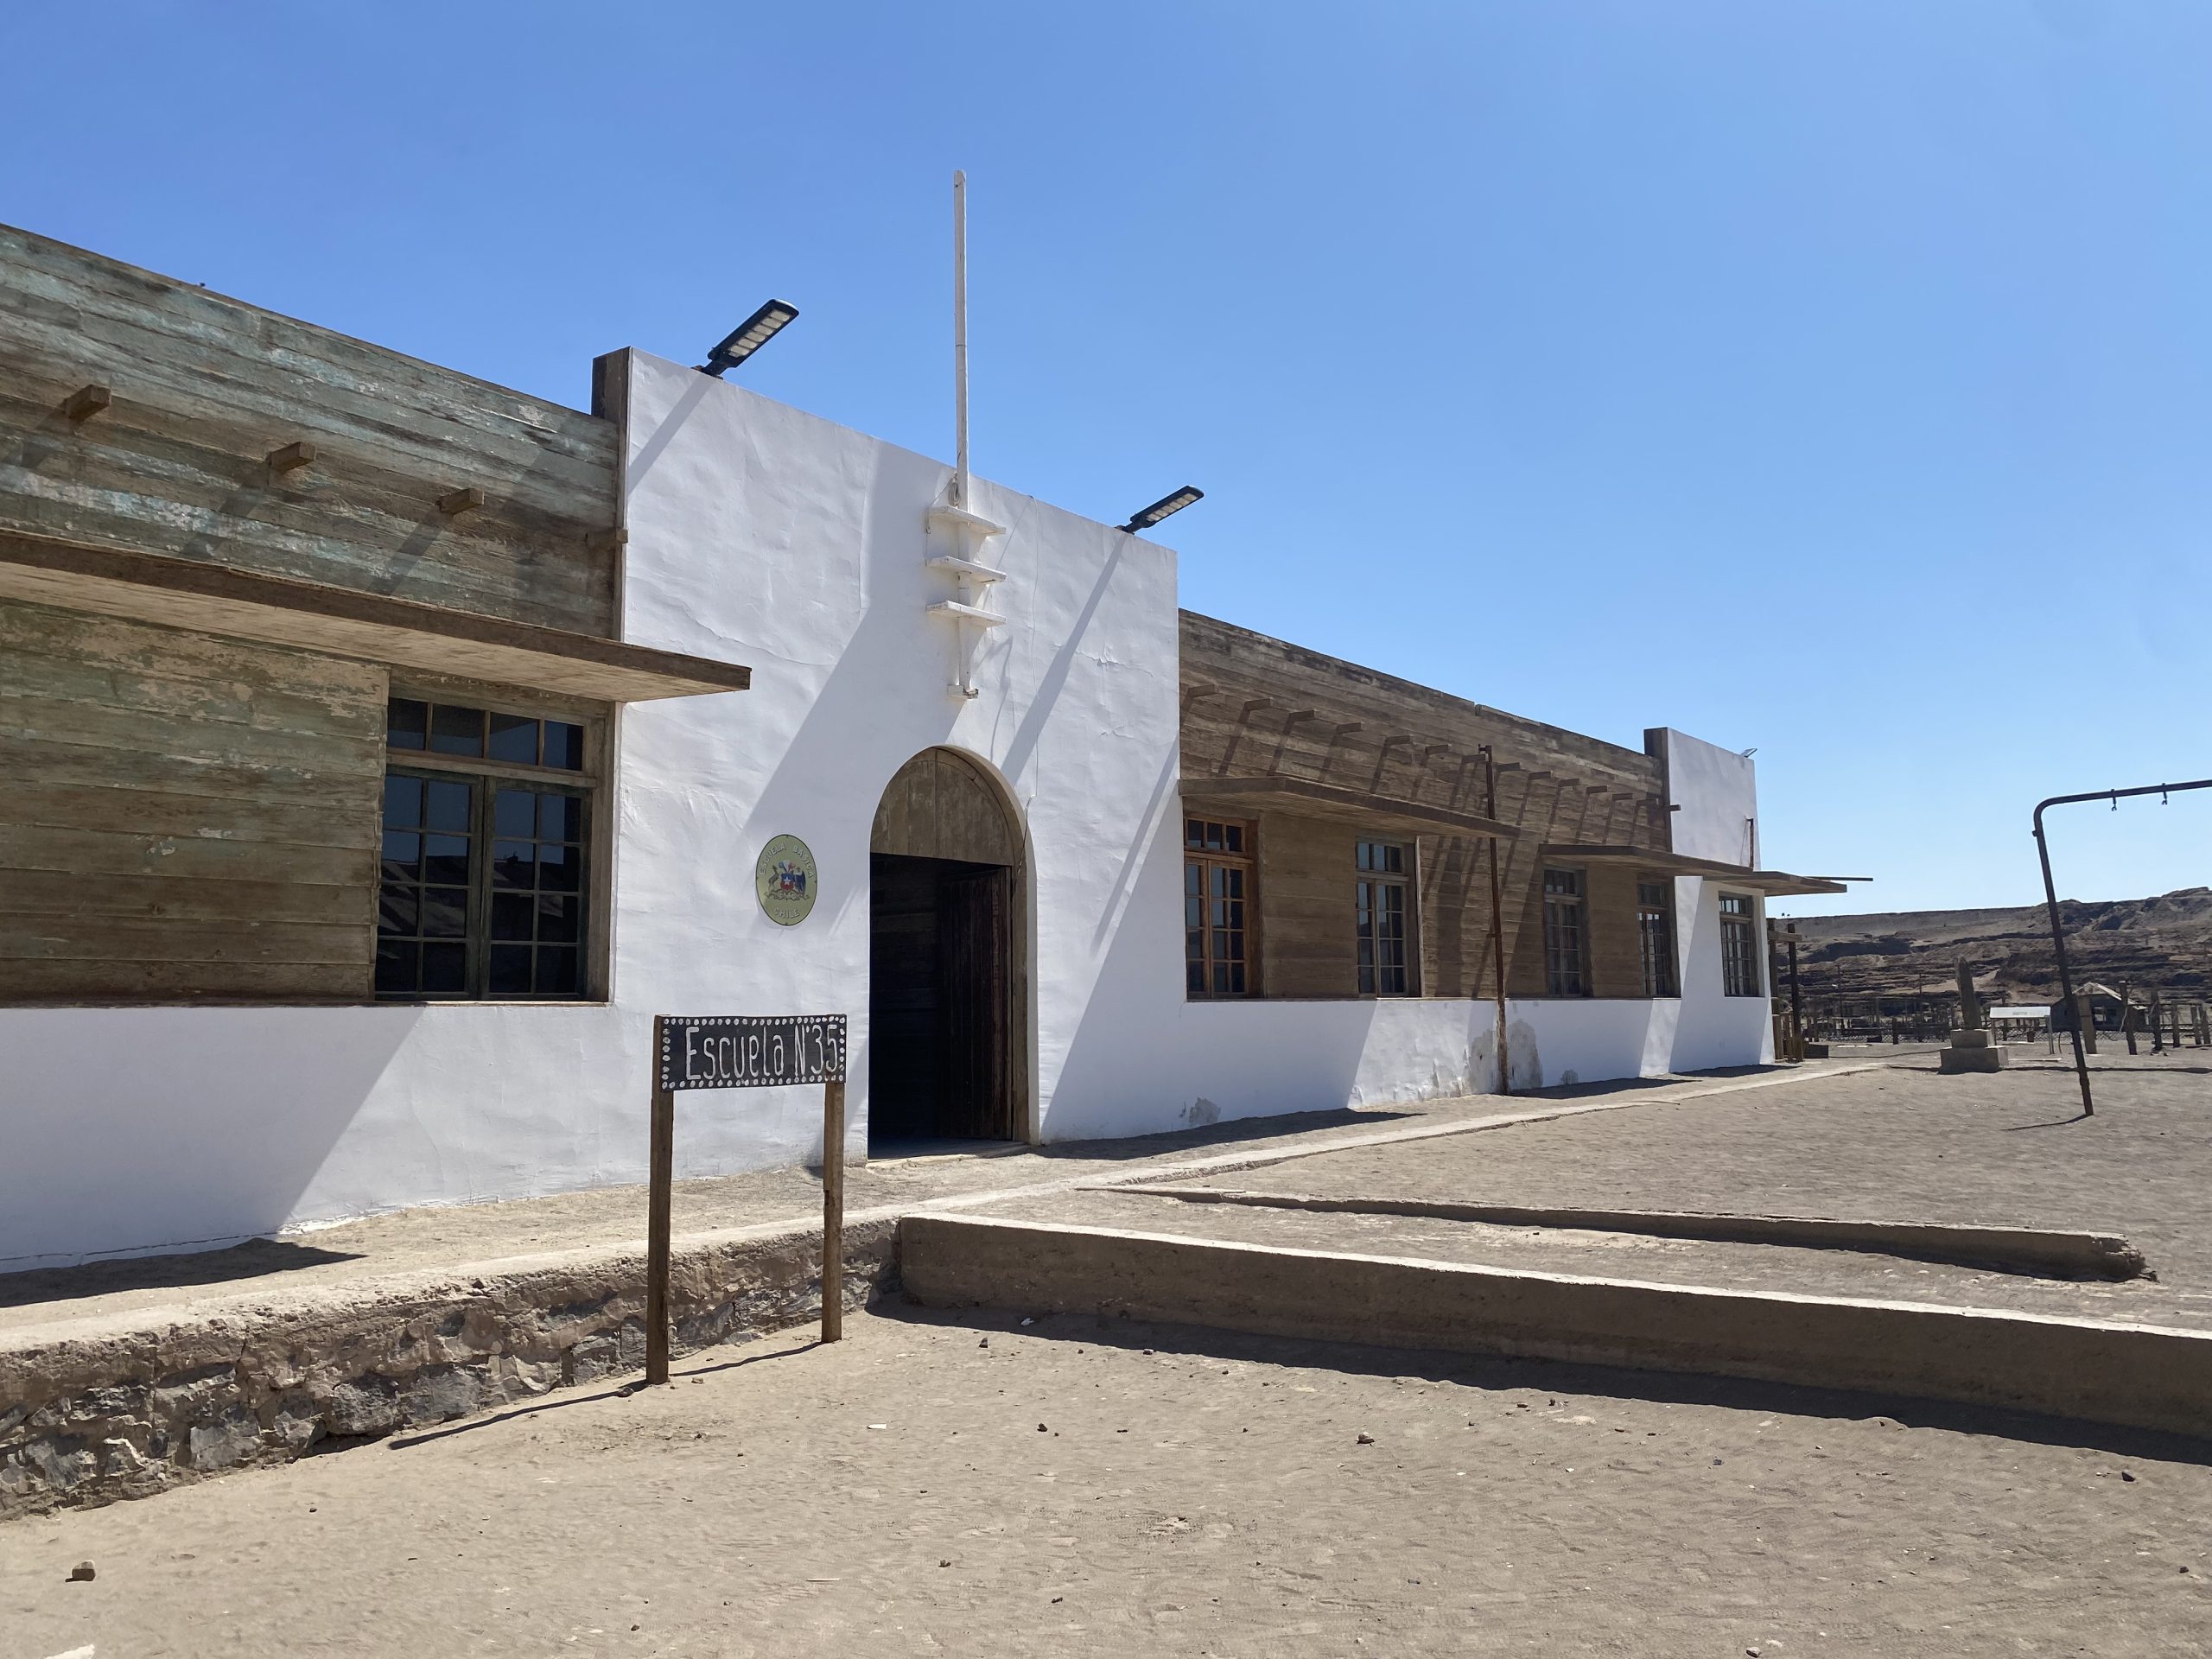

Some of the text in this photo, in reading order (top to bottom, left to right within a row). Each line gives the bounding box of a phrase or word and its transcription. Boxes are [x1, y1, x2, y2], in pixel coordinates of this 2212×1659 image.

[760, 842, 786, 875] ESCUELA
[774, 907, 800, 919] CHILE
[685, 1025, 785, 1080] Escuela
